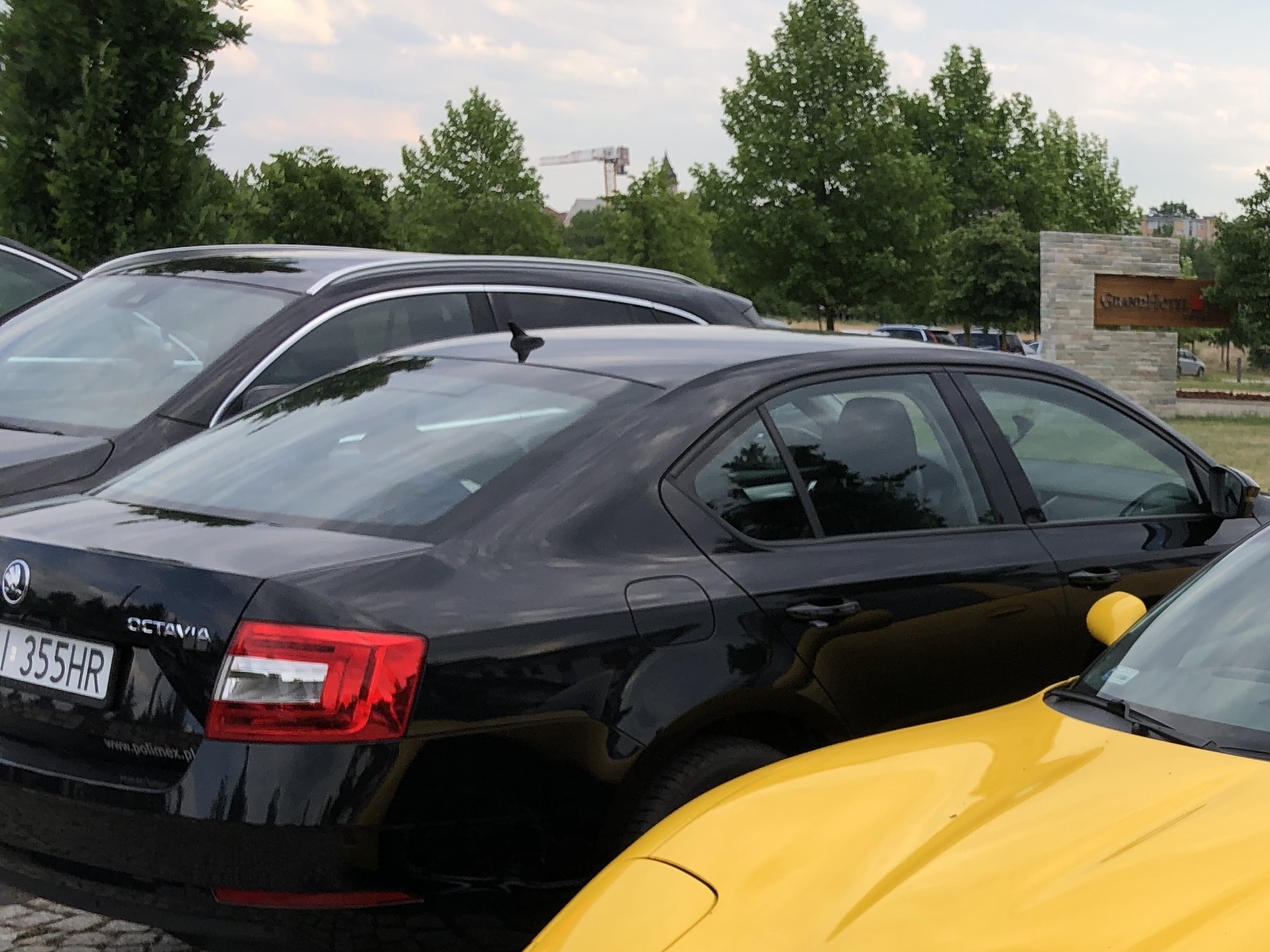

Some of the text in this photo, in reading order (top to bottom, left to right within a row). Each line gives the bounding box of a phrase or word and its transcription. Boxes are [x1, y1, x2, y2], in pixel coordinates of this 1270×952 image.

[127, 616, 211, 643] OCTAVIA
[20, 634, 105, 694] 355HR
[103, 737, 195, 763] www.polimex.pl
